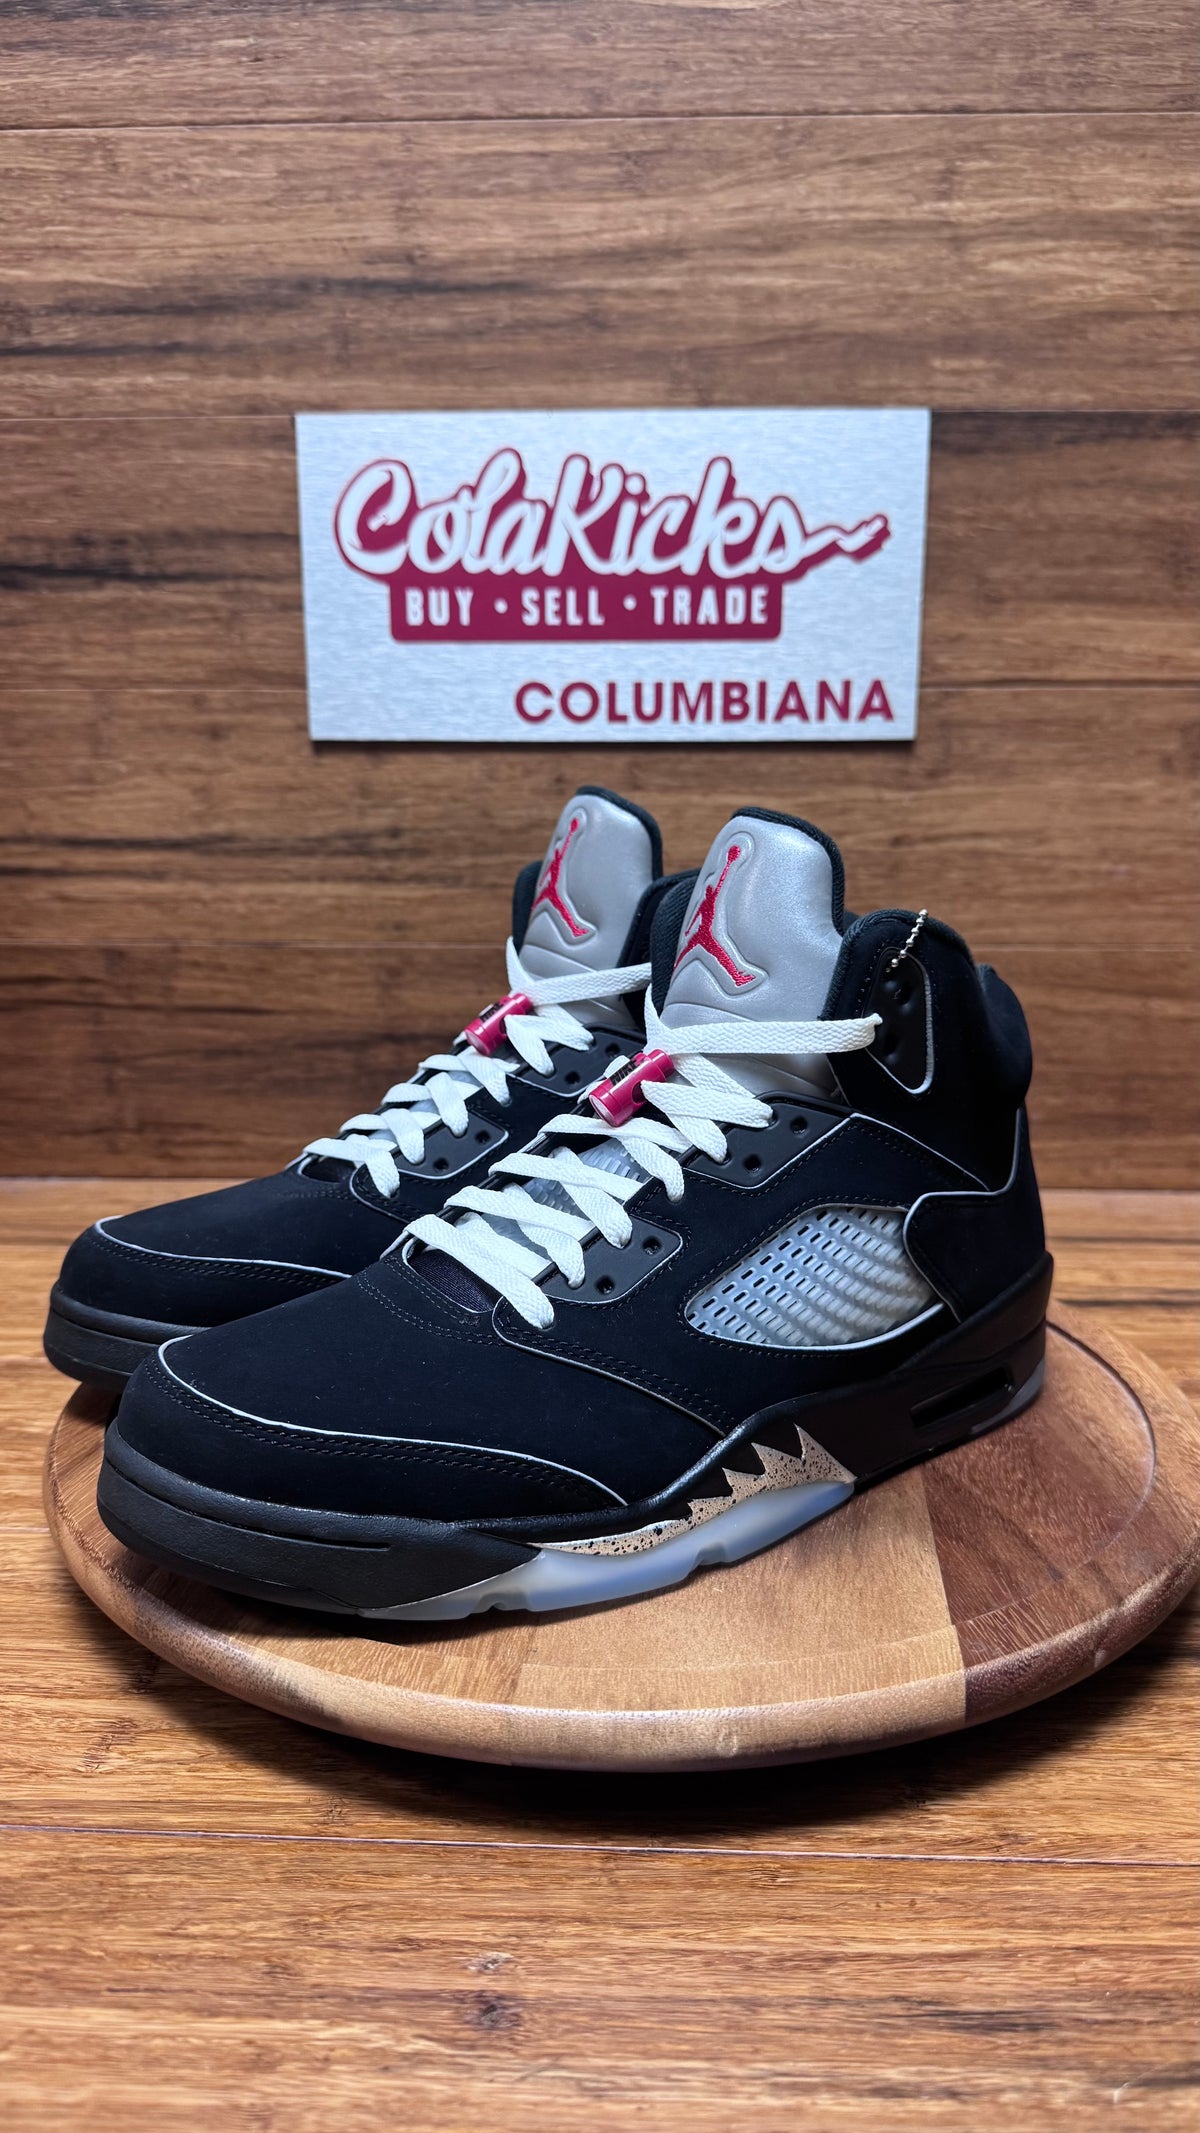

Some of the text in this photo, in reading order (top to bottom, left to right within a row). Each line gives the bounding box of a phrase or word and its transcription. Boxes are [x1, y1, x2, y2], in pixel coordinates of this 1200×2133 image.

[336, 448, 890, 579] ColaKicks
[404, 585, 769, 626] BUY SELL TRADE
[515, 680, 894, 723] COLUMBIANA
[610, 1059, 638, 1087] NIKE
